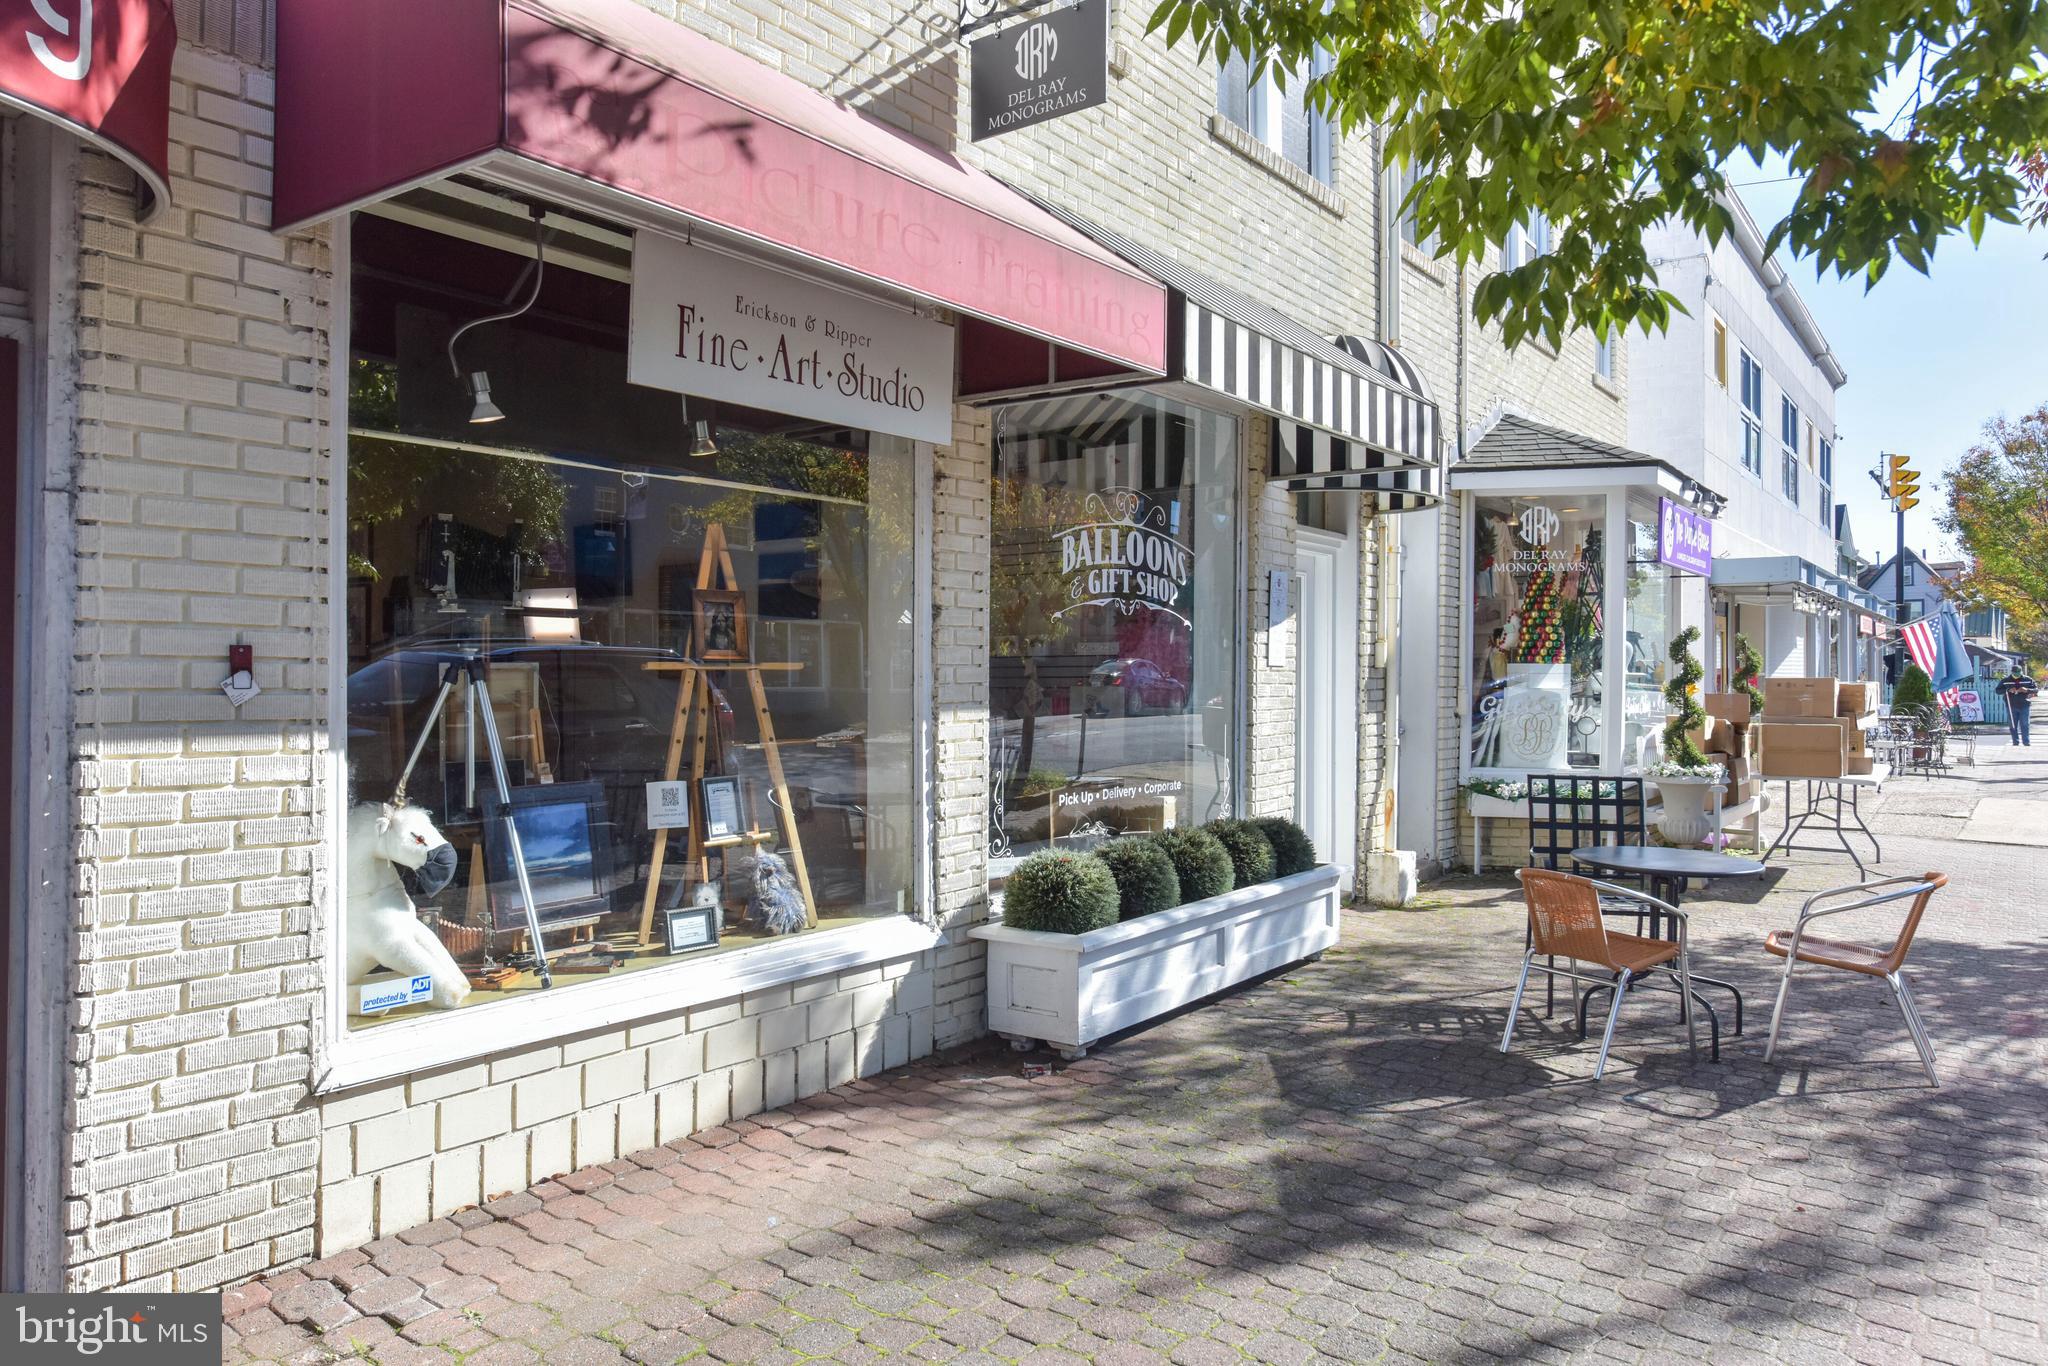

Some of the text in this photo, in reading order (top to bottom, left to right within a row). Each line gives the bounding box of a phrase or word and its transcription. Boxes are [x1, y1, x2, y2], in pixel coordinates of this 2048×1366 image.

[1008, 77, 1067, 107] DEL RAY
[988, 88, 1087, 130] MONOGRAMS
[735, 295, 871, 348] Erickson & Ripper
[675, 304, 924, 411] Fine Art Studio
[1062, 528, 1187, 586] BALLOONS
[1494, 561, 1586, 572] MONOGRAMS
[1513, 550, 1567, 560] DEL RAY
[1070, 569, 1179, 606] & GIFT SHOP
[1058, 780, 1181, 806] Pick Up Delivery Corporate
[363, 992, 399, 1008] protected
[400, 991, 408, 1001] by
[412, 979, 430, 991] ADT
